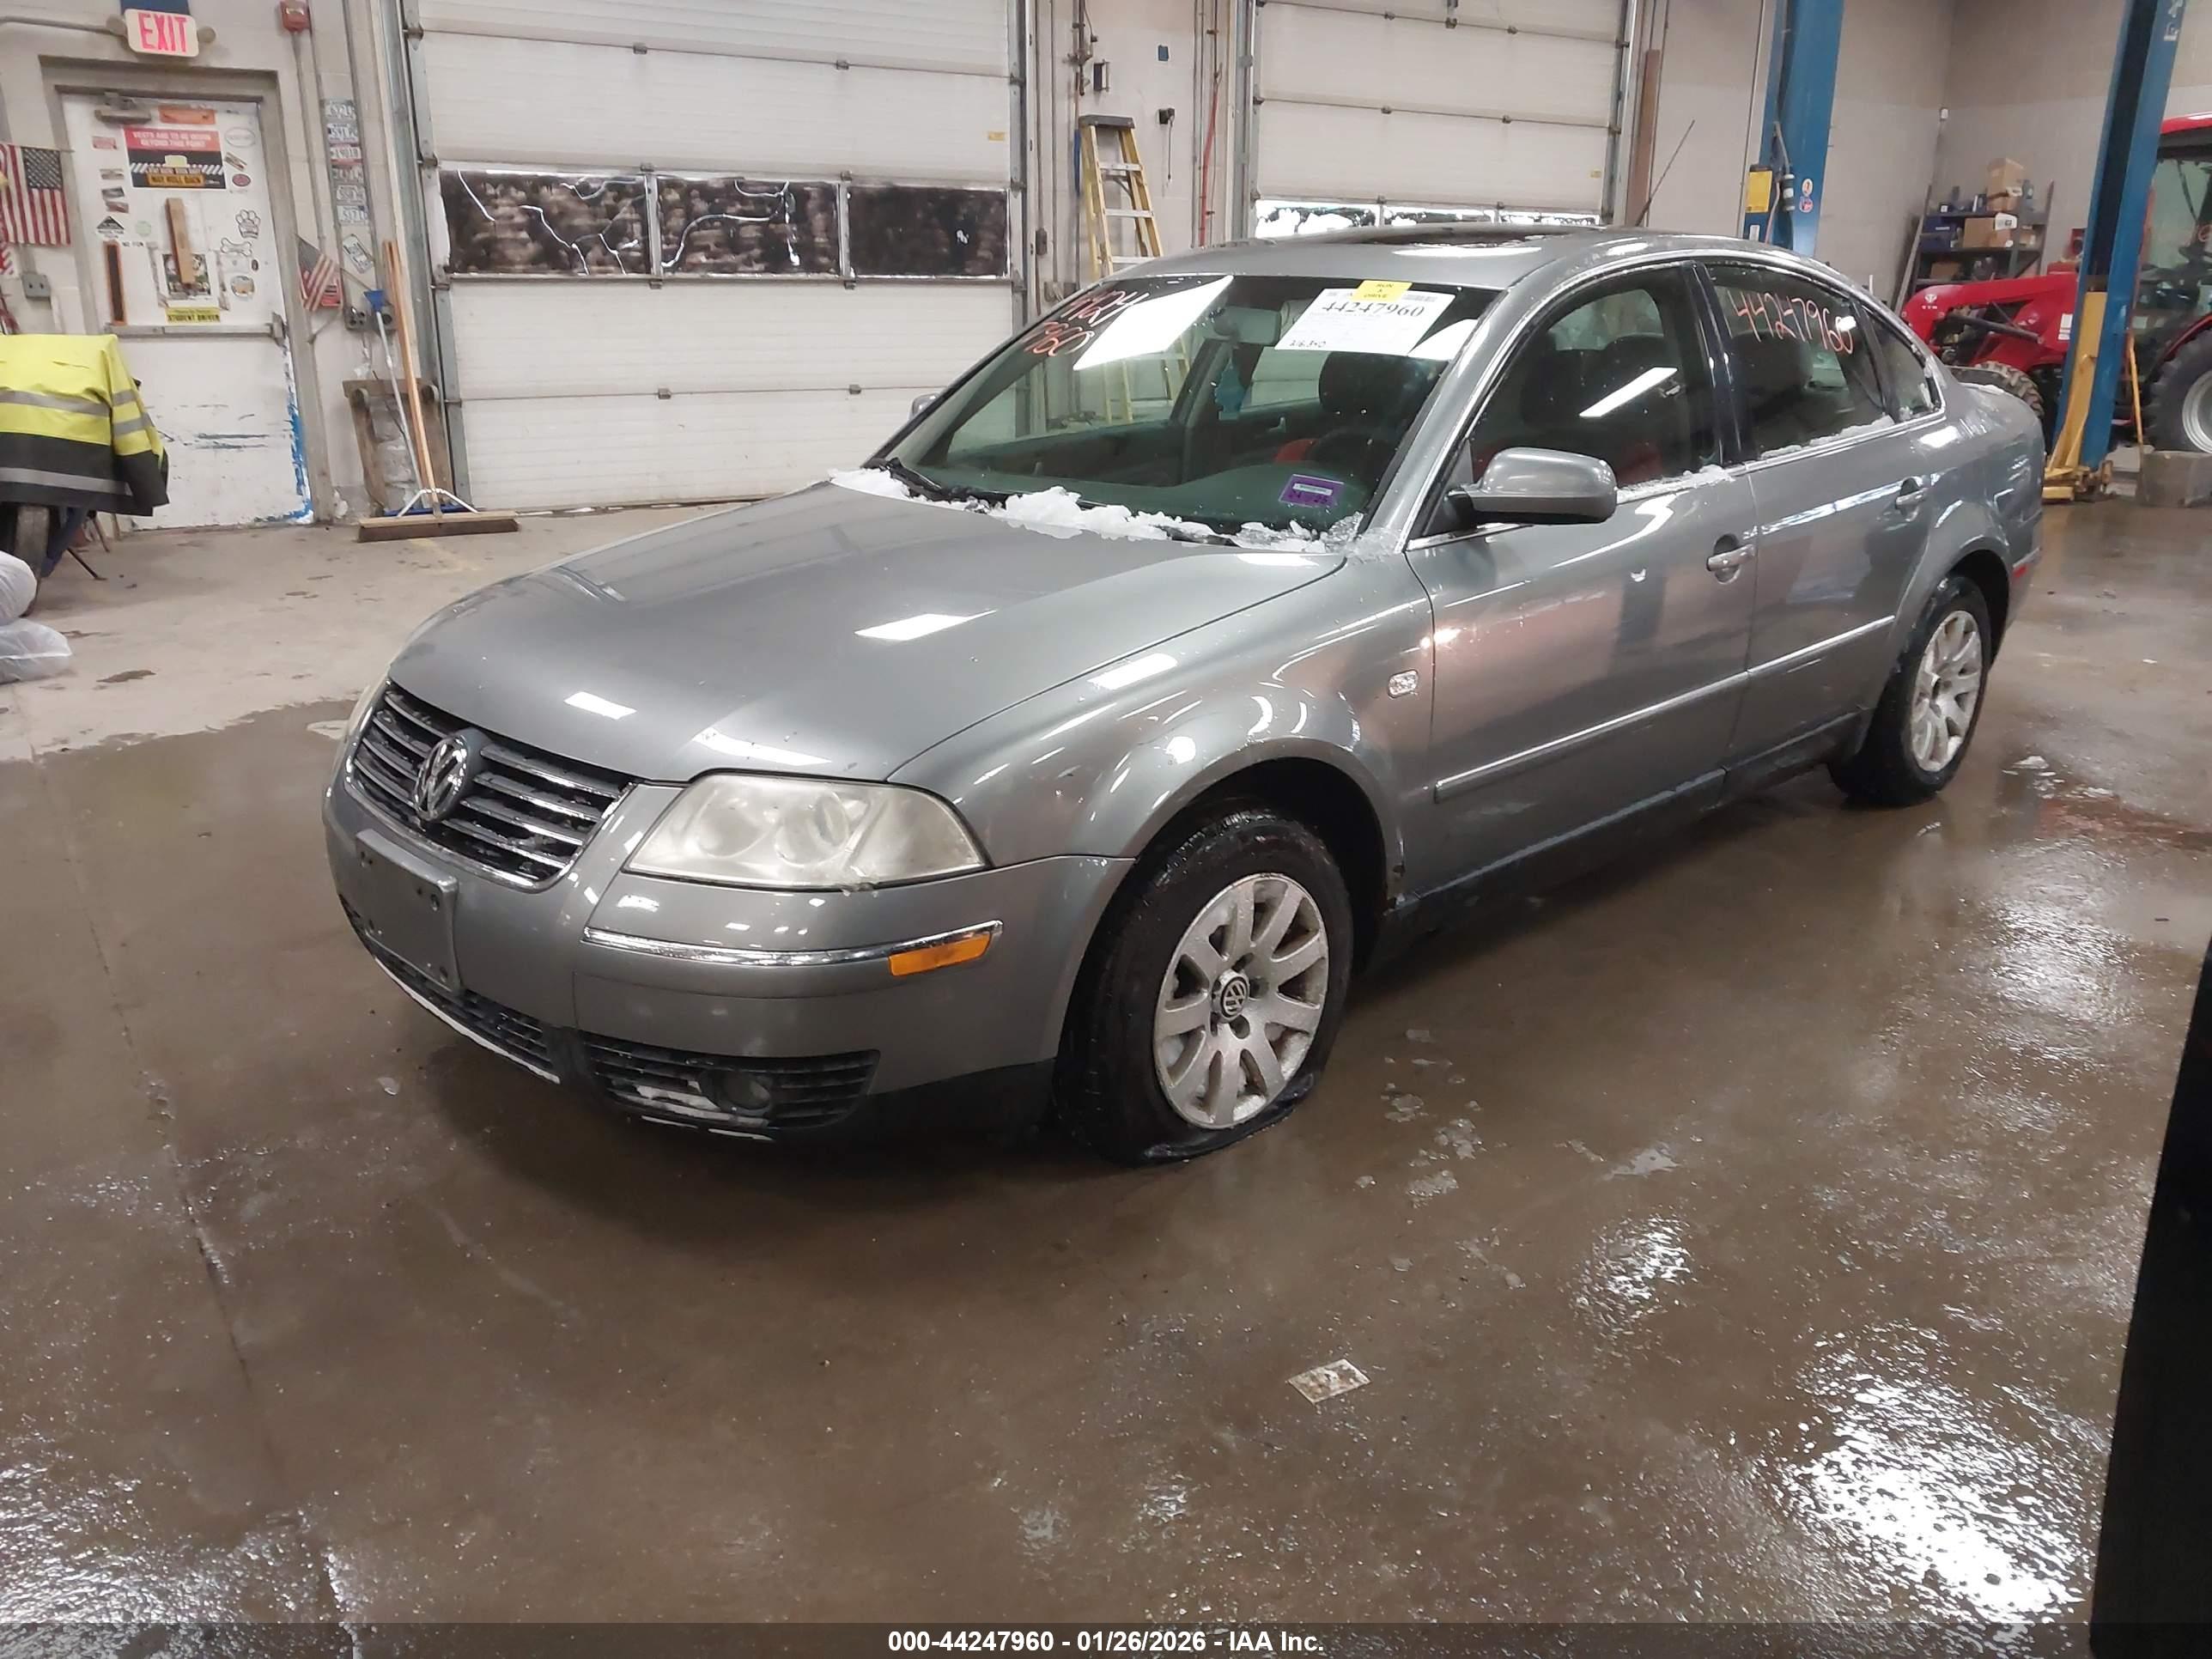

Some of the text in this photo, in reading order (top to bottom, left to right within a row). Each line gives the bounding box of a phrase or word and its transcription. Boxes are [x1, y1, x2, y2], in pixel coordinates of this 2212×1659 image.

[138, 12, 187, 53] EXIT
[1321, 301, 1425, 318] 44247960
[1727, 289, 1854, 355] 44247960
